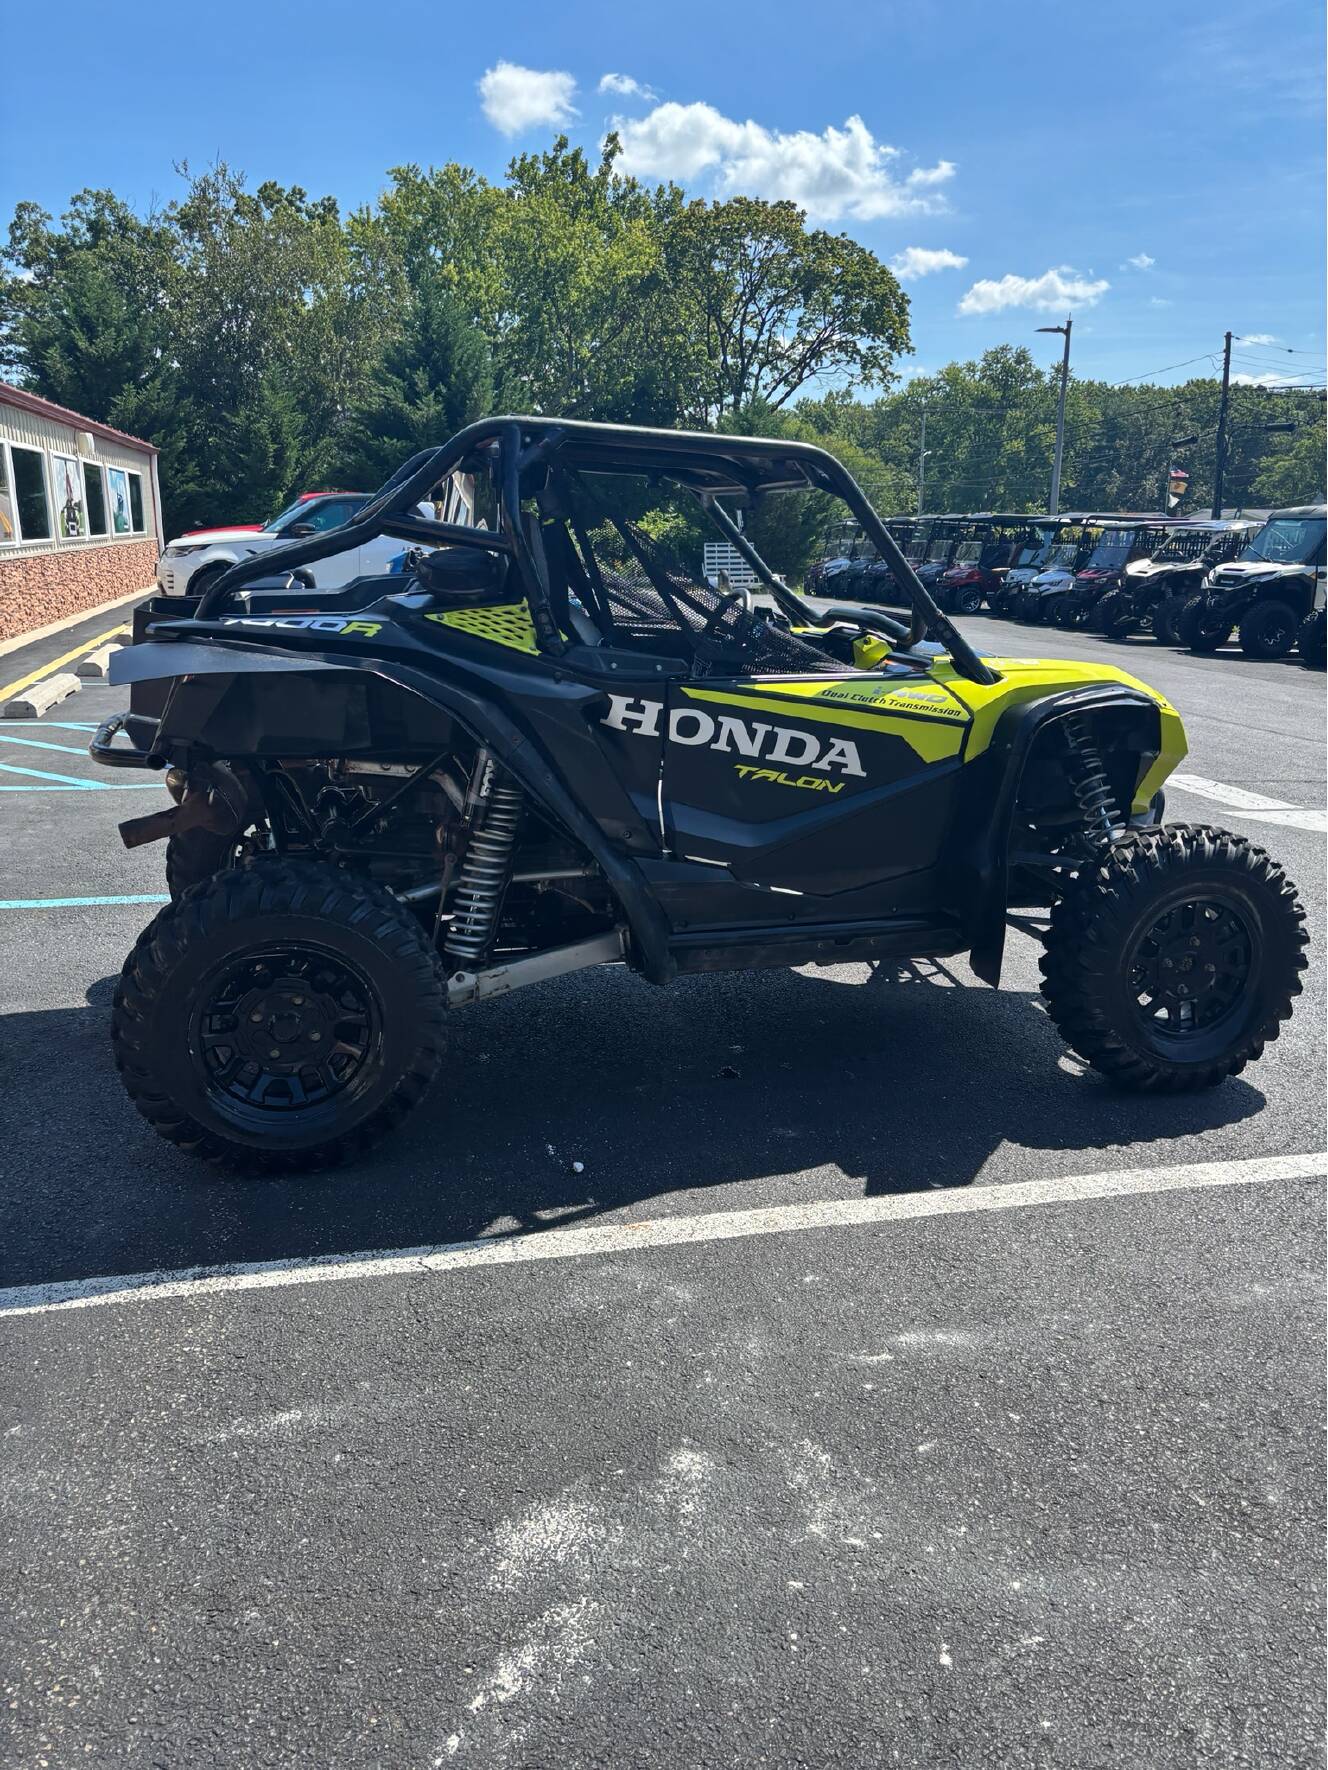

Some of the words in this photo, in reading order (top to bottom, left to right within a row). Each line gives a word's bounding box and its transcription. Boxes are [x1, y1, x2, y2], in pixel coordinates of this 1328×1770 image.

[821, 689, 849, 699] Dual
[850, 692, 887, 705] Clutch
[888, 699, 963, 718] Transmission
[600, 693, 867, 778] HONDA
[733, 763, 847, 793] TALON
